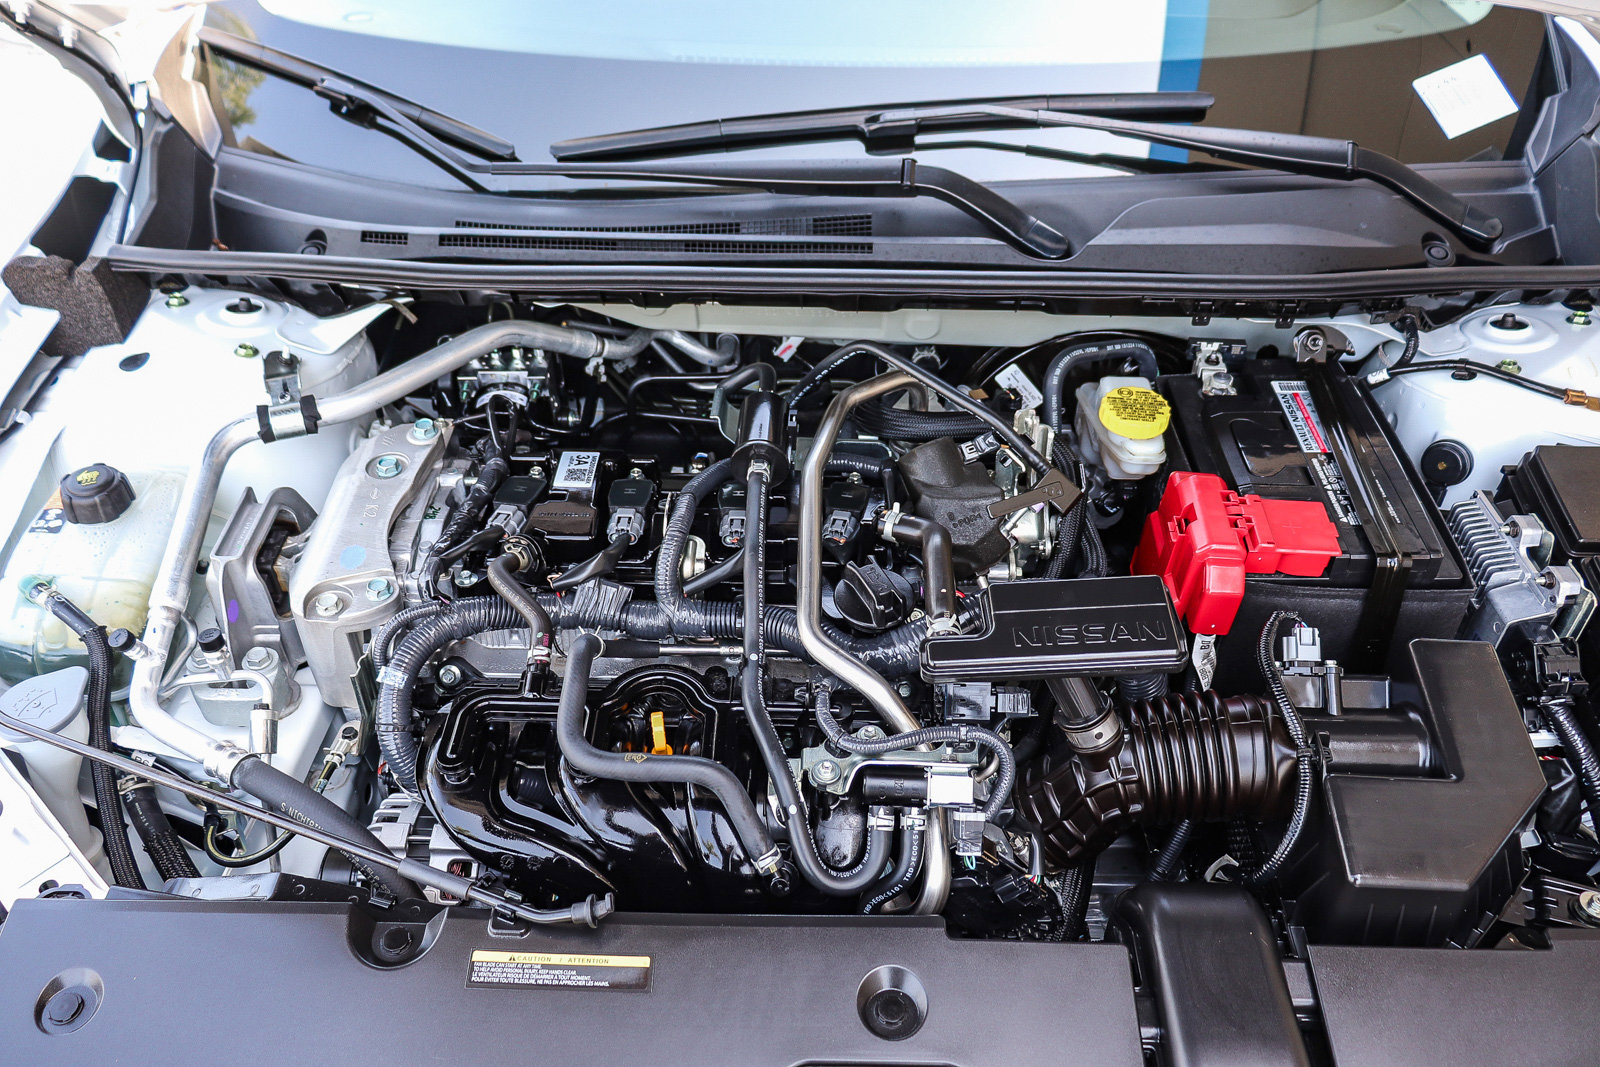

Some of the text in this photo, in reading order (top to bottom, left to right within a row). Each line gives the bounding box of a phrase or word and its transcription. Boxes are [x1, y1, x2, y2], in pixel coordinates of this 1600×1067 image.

[1281, 393, 1300, 423] NISSAN
[1295, 423, 1314, 451] RENAULT
[574, 455, 590, 466] 3A
[1012, 620, 1168, 648] NISSAN
